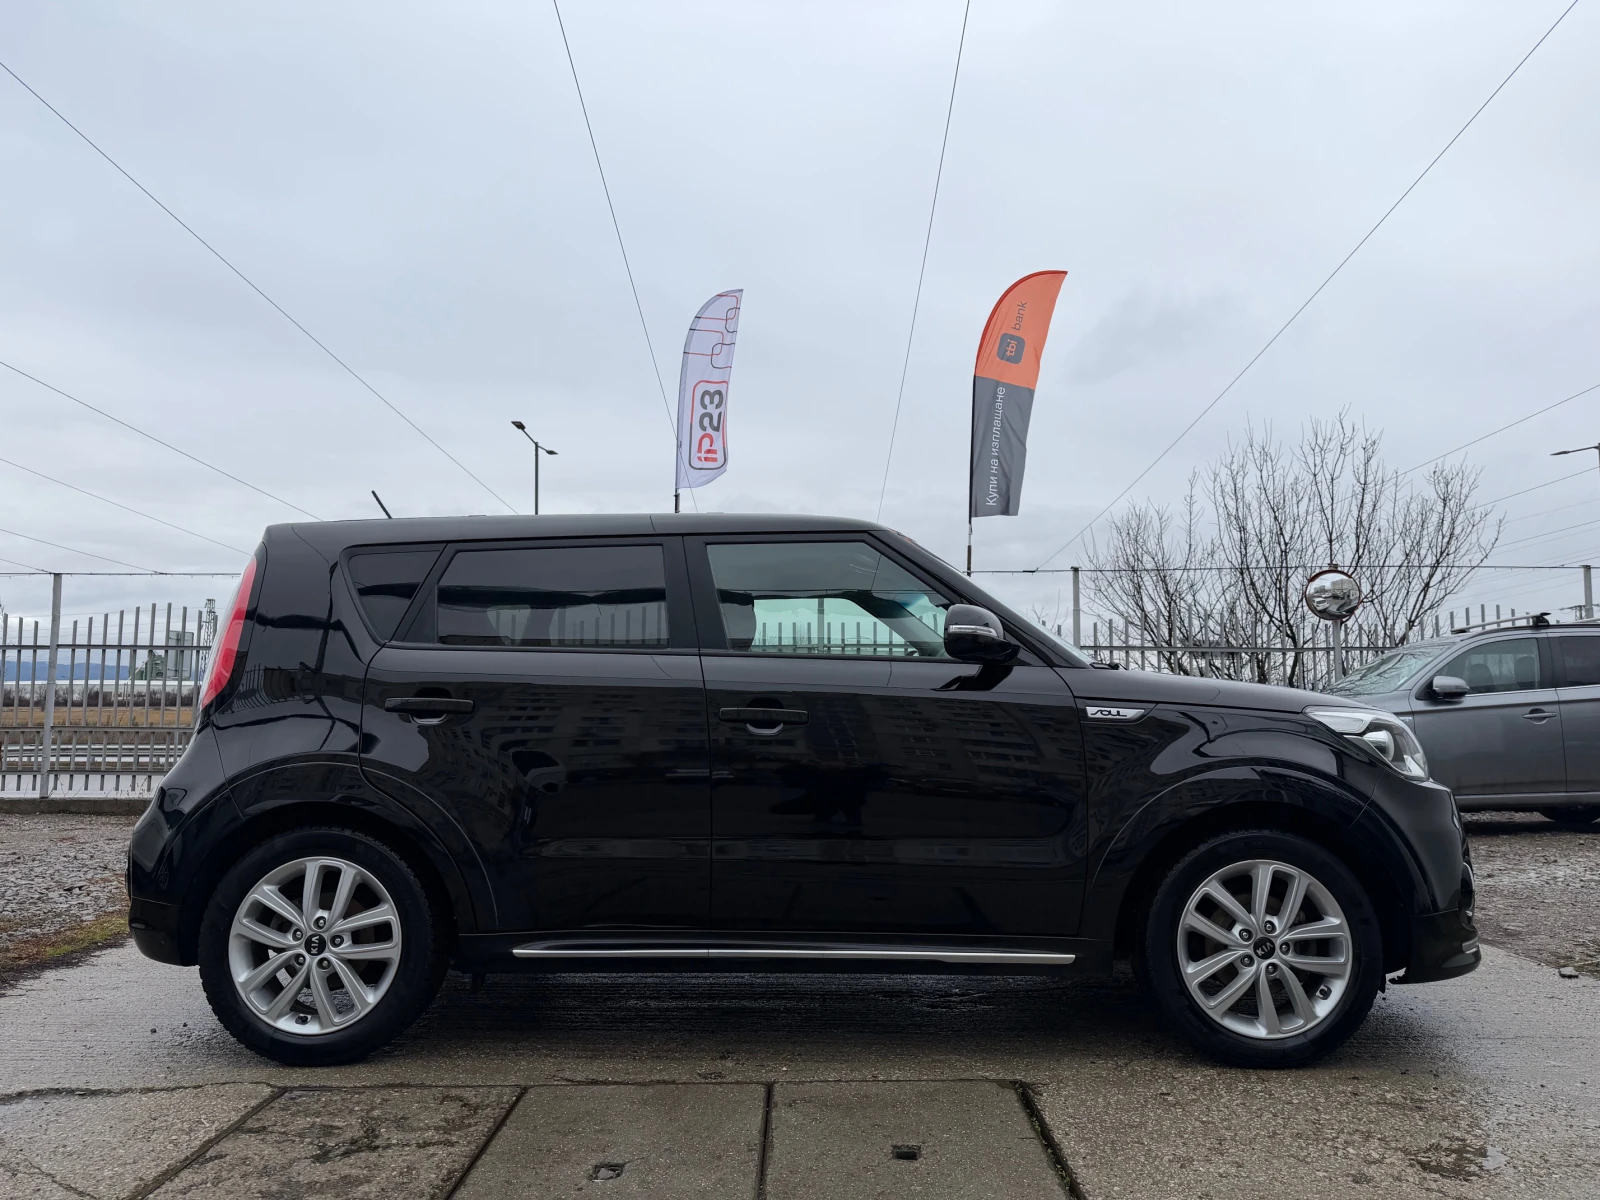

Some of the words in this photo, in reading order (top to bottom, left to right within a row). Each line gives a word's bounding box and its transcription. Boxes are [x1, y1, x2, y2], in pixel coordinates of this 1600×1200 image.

[1011, 301, 1028, 331] bank
[1005, 339, 1018, 357] tbi
[991, 386, 1006, 456] изплащане
[990, 459, 999, 474] на
[985, 477, 999, 506] Купи
[310, 935, 320, 954] KIA
[1256, 941, 1275, 957] KIA
